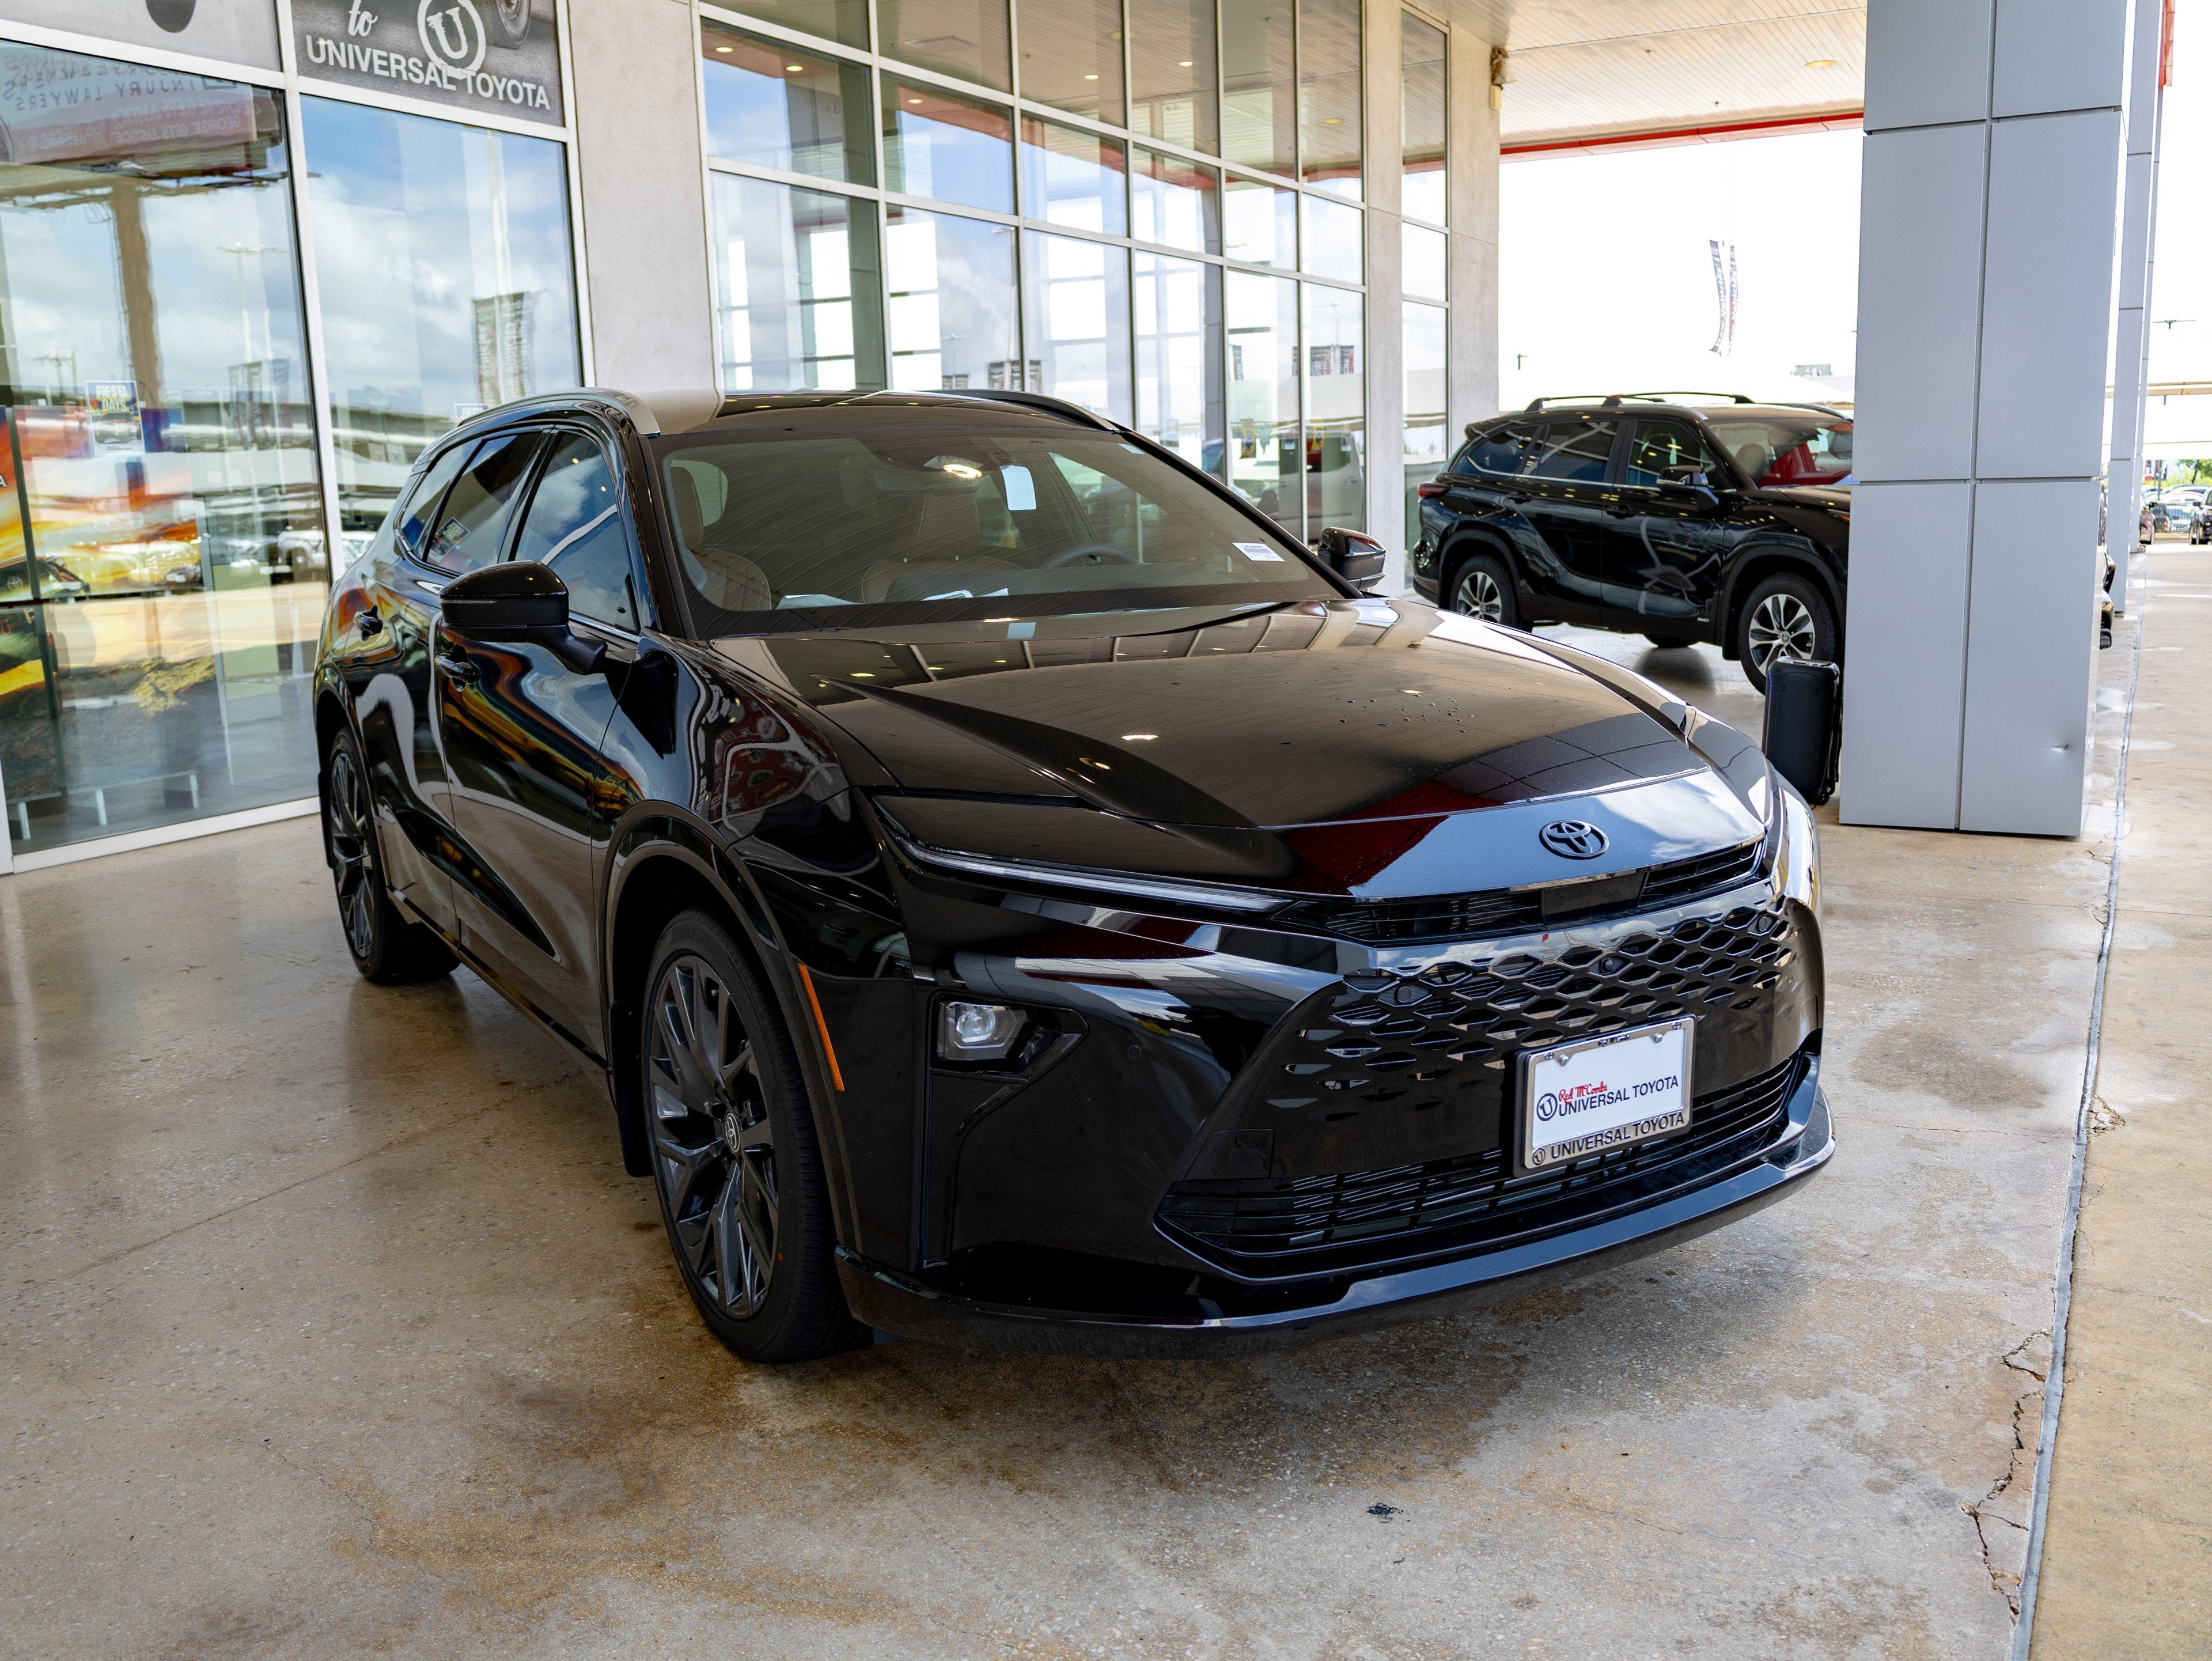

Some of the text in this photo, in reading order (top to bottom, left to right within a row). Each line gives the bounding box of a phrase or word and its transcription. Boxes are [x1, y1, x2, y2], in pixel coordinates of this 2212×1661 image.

[347, 0, 378, 37] to
[306, 35, 551, 110] UNIVERSAL TOYOTA
[96, 385, 130, 399] FIESTA
[102, 399, 127, 412] DAYS
[1559, 1088, 1573, 1104] Red
[1559, 1075, 1679, 1117] UNIVERSAL TOYOTA
[1551, 1111, 1684, 1159] UNIVERSAL TOYOTA
